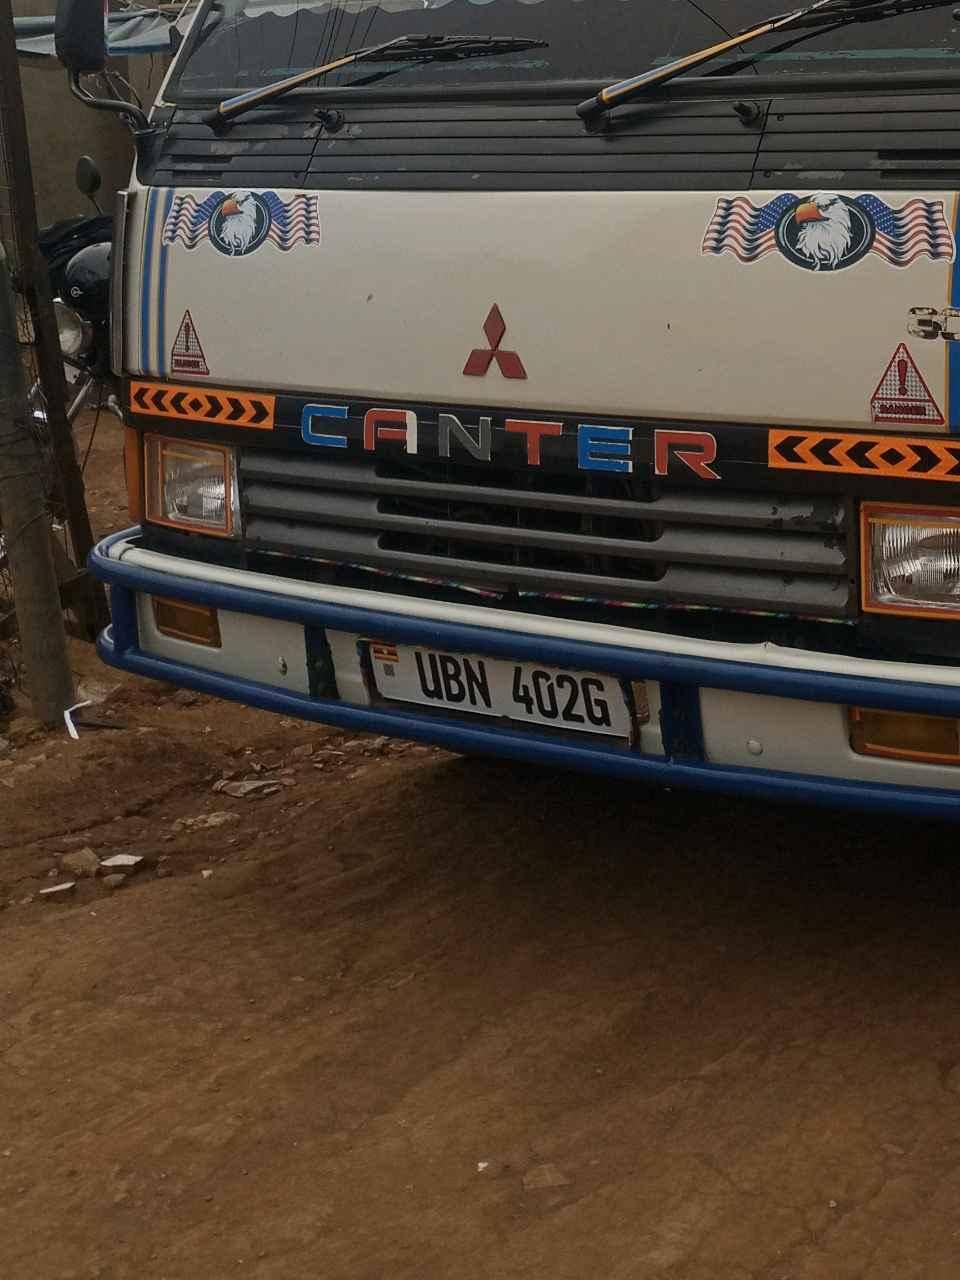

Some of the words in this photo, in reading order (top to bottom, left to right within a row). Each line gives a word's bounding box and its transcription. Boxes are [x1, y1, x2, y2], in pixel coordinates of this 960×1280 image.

[301, 403, 723, 480] CANTER
[414, 650, 492, 709] UBN
[511, 665, 613, 728] 402G
